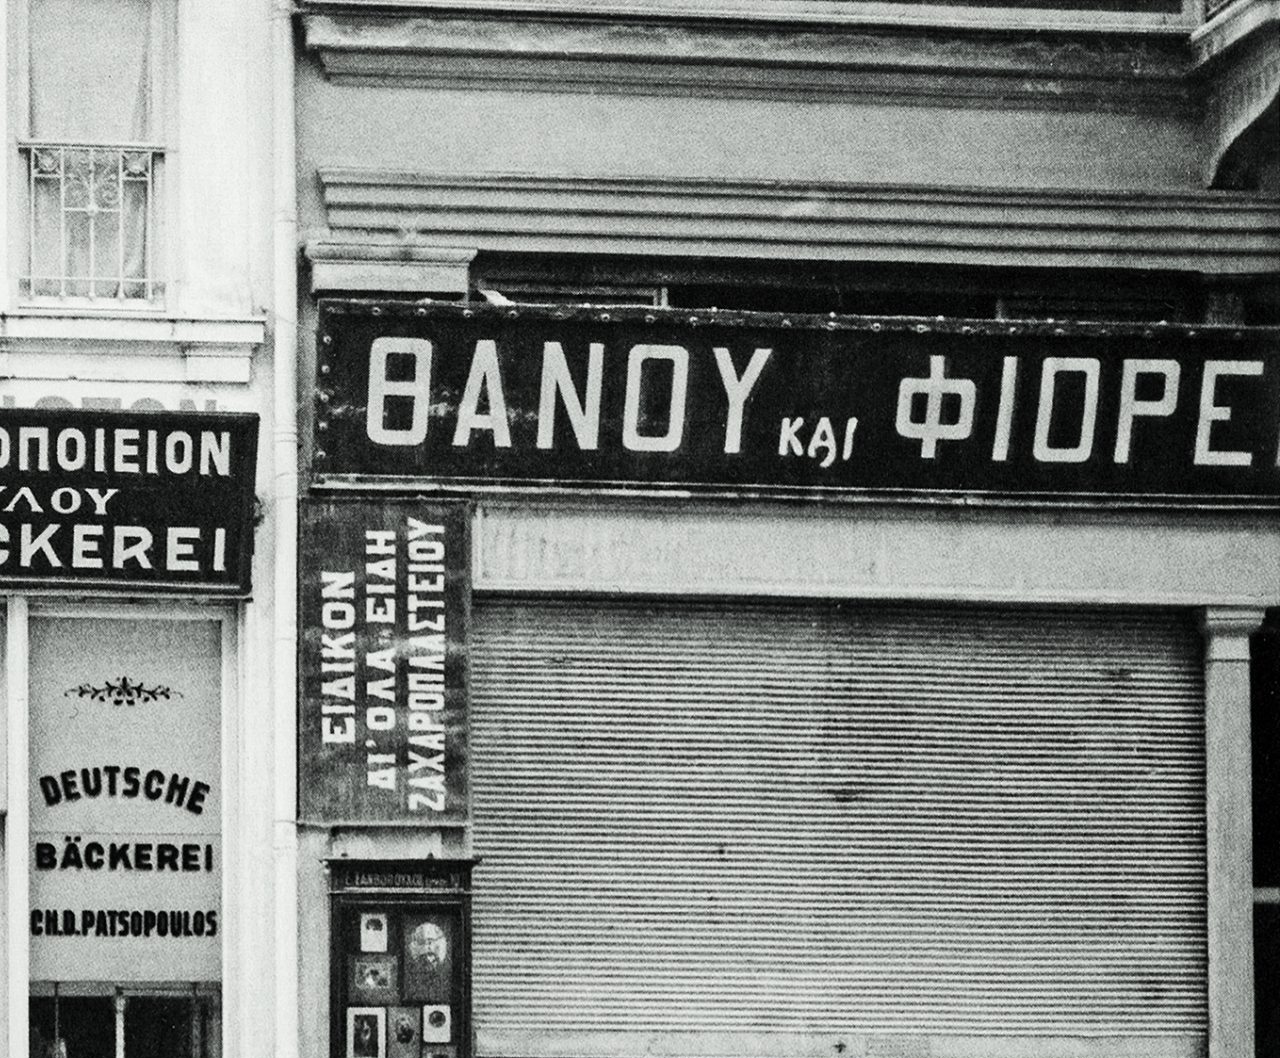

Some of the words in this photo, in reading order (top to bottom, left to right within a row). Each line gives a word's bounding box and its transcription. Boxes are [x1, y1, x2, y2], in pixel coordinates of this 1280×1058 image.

[366, 336, 773, 454] ΘΑΝΟΥ
[778, 416, 858, 468] ΚΑΙ
[895, 355, 1280, 466] ΦΙΟΡΕ
[366, 530, 396, 624] ΕΙΔΗ
[321, 571, 356, 744] ΕΙΔΙΚΟΝ
[407, 516, 445, 812] ΖΑΧΑΡΟΠΛΑΣΤΕΙΟΥ
[39, 766, 210, 815] DEUTSCHE
[35, 835, 213, 872] BÄCKEREI
